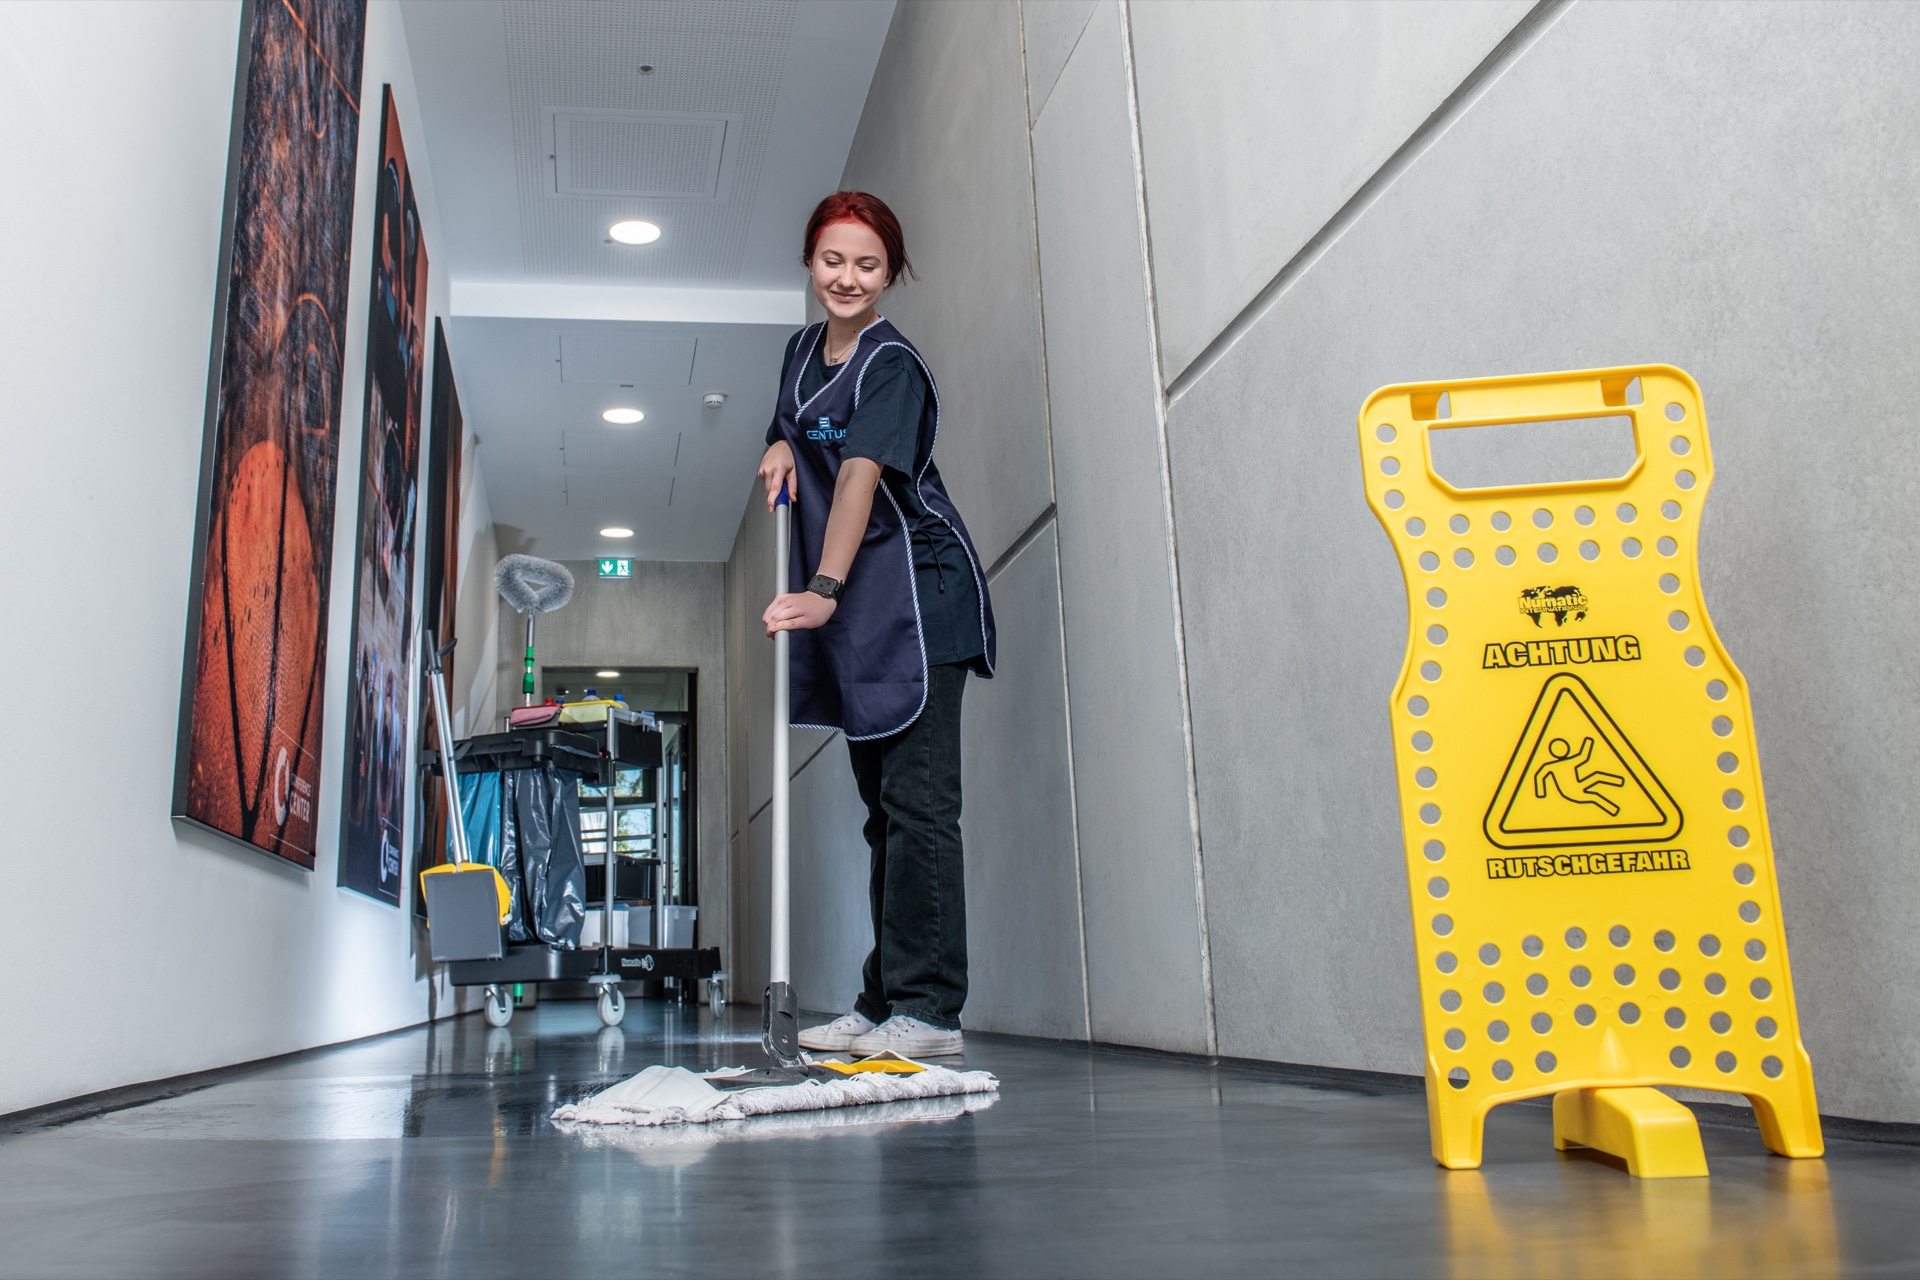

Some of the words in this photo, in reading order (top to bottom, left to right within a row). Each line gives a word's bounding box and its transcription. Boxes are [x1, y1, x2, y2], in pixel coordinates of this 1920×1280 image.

[1518, 593, 1589, 609] Numatic
[1482, 635, 1641, 669] ACHTUNG
[1486, 849, 1691, 879] RUTSCHGEFAHR
